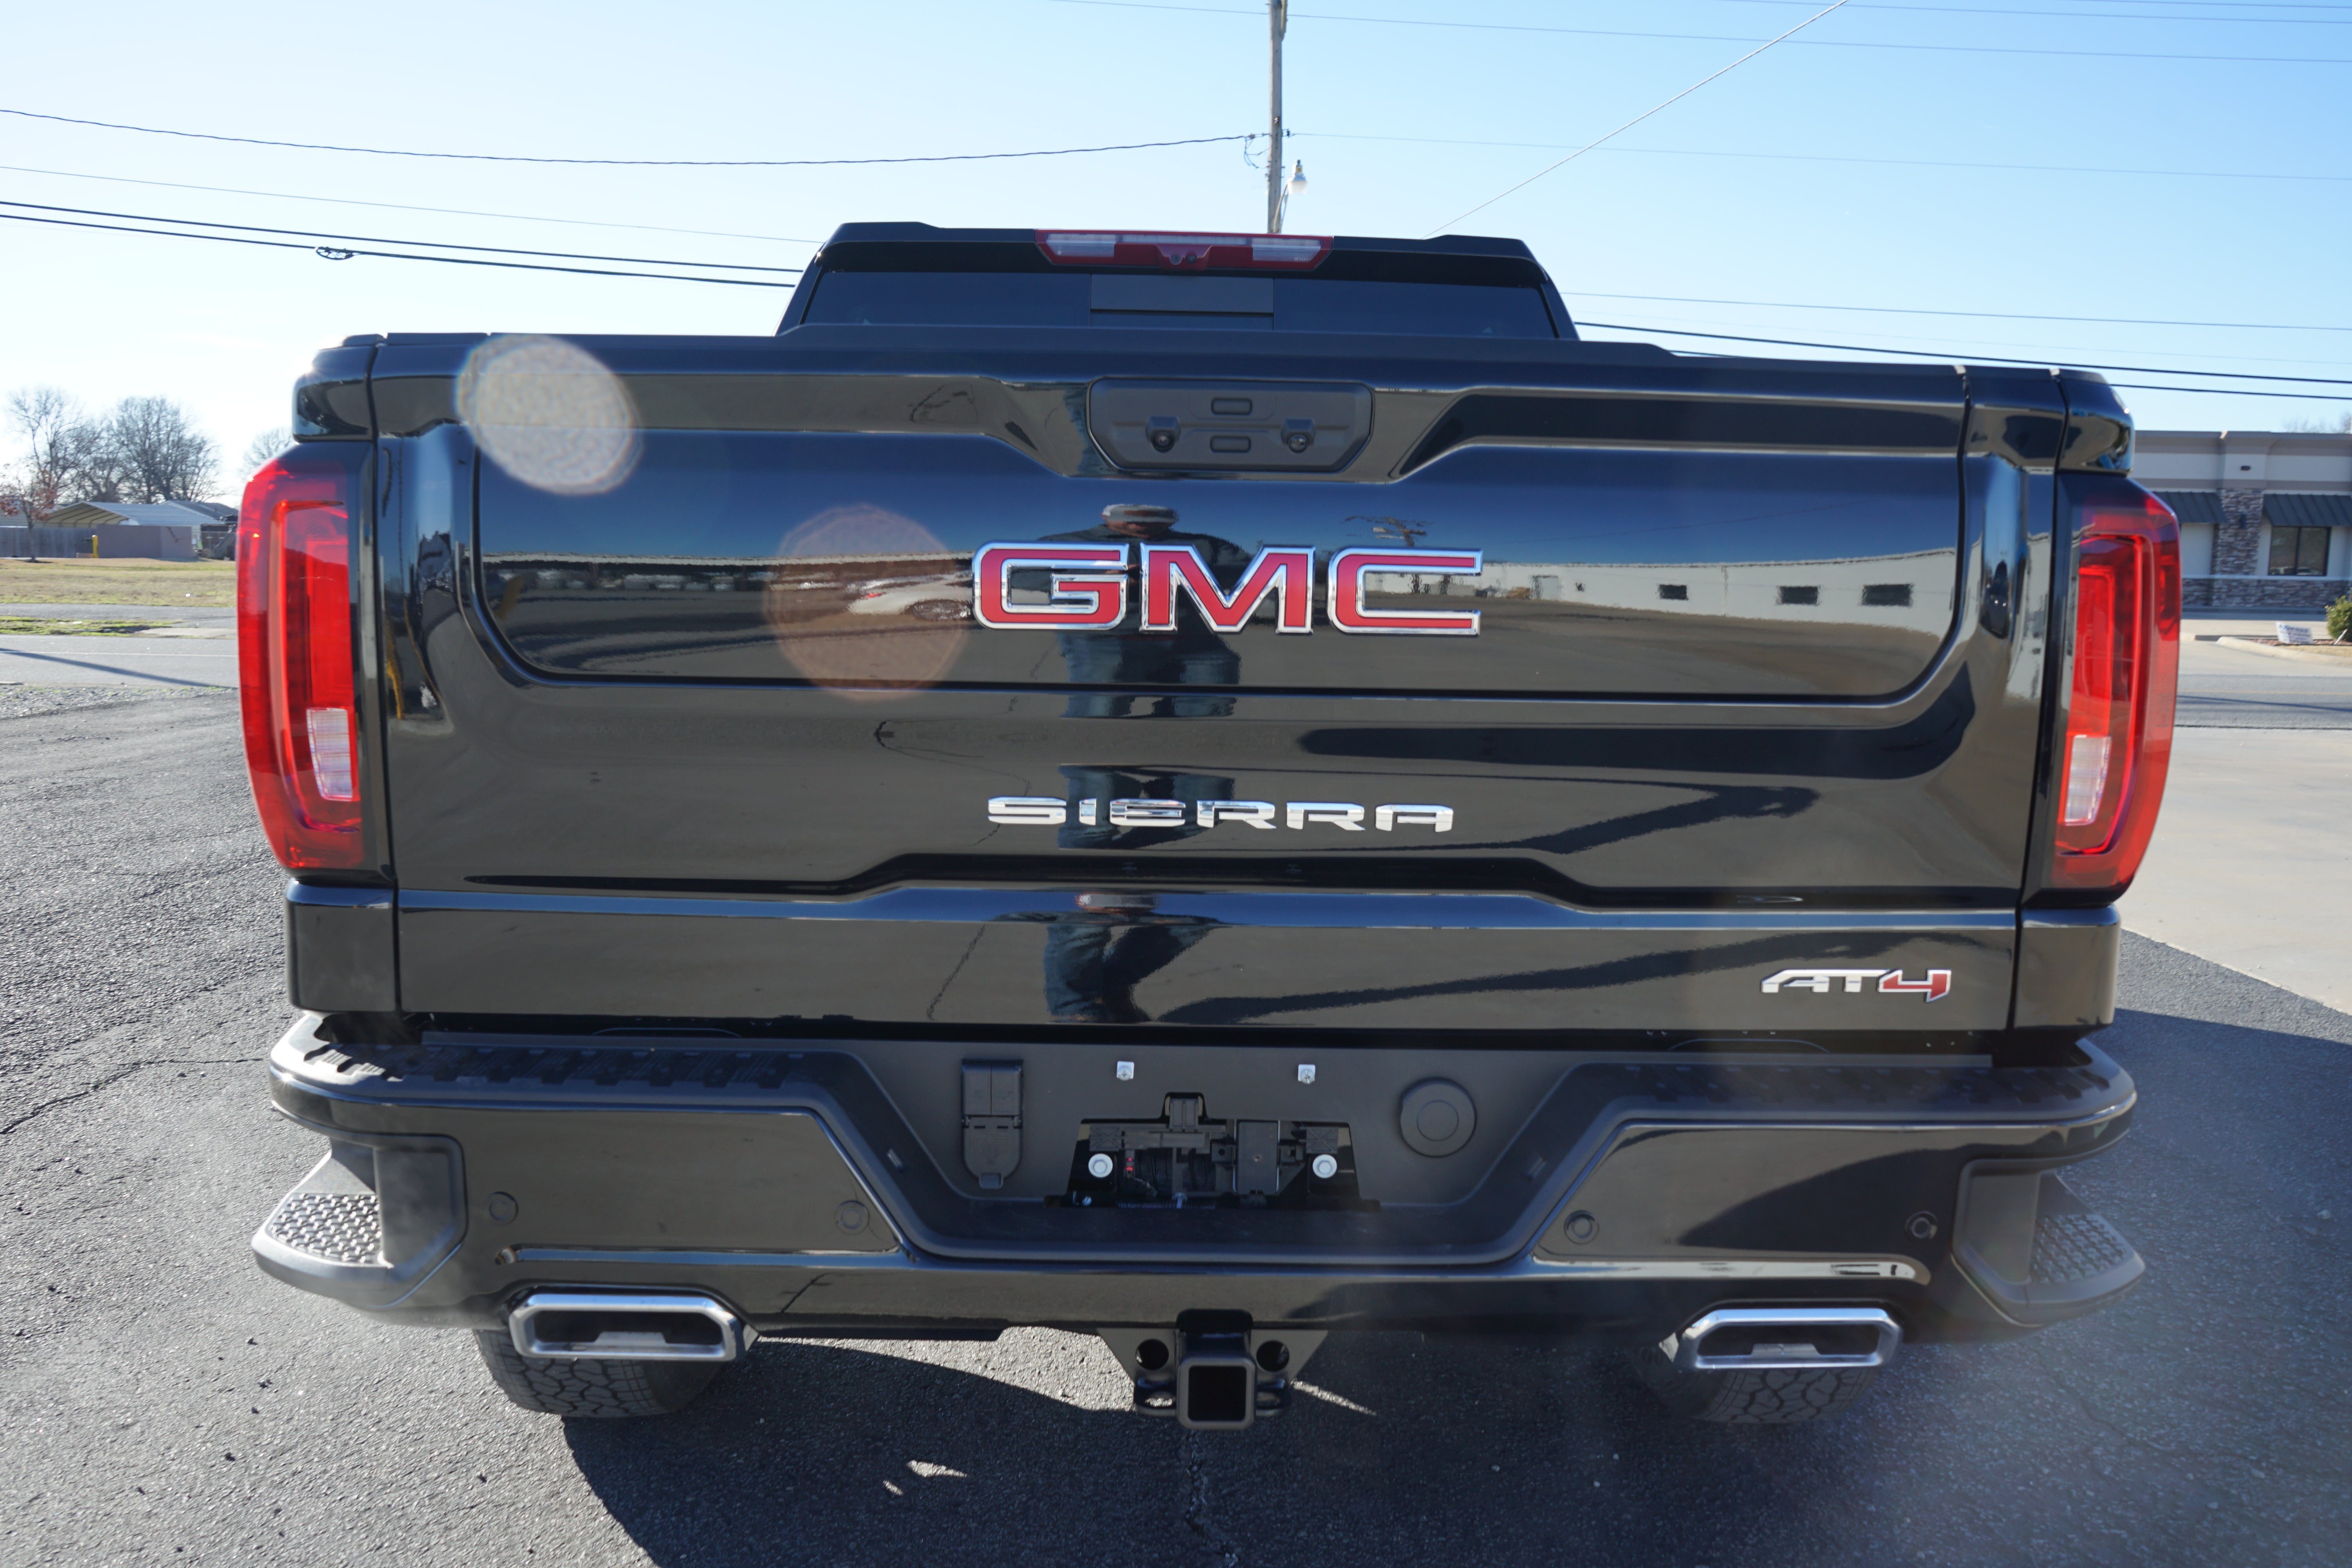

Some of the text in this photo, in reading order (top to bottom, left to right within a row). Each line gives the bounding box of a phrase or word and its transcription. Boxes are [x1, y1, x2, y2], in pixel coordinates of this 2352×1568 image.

[973, 543, 1483, 635] GMC
[988, 797, 1453, 831] SIERRA
[1761, 969, 1951, 1002] AT4
